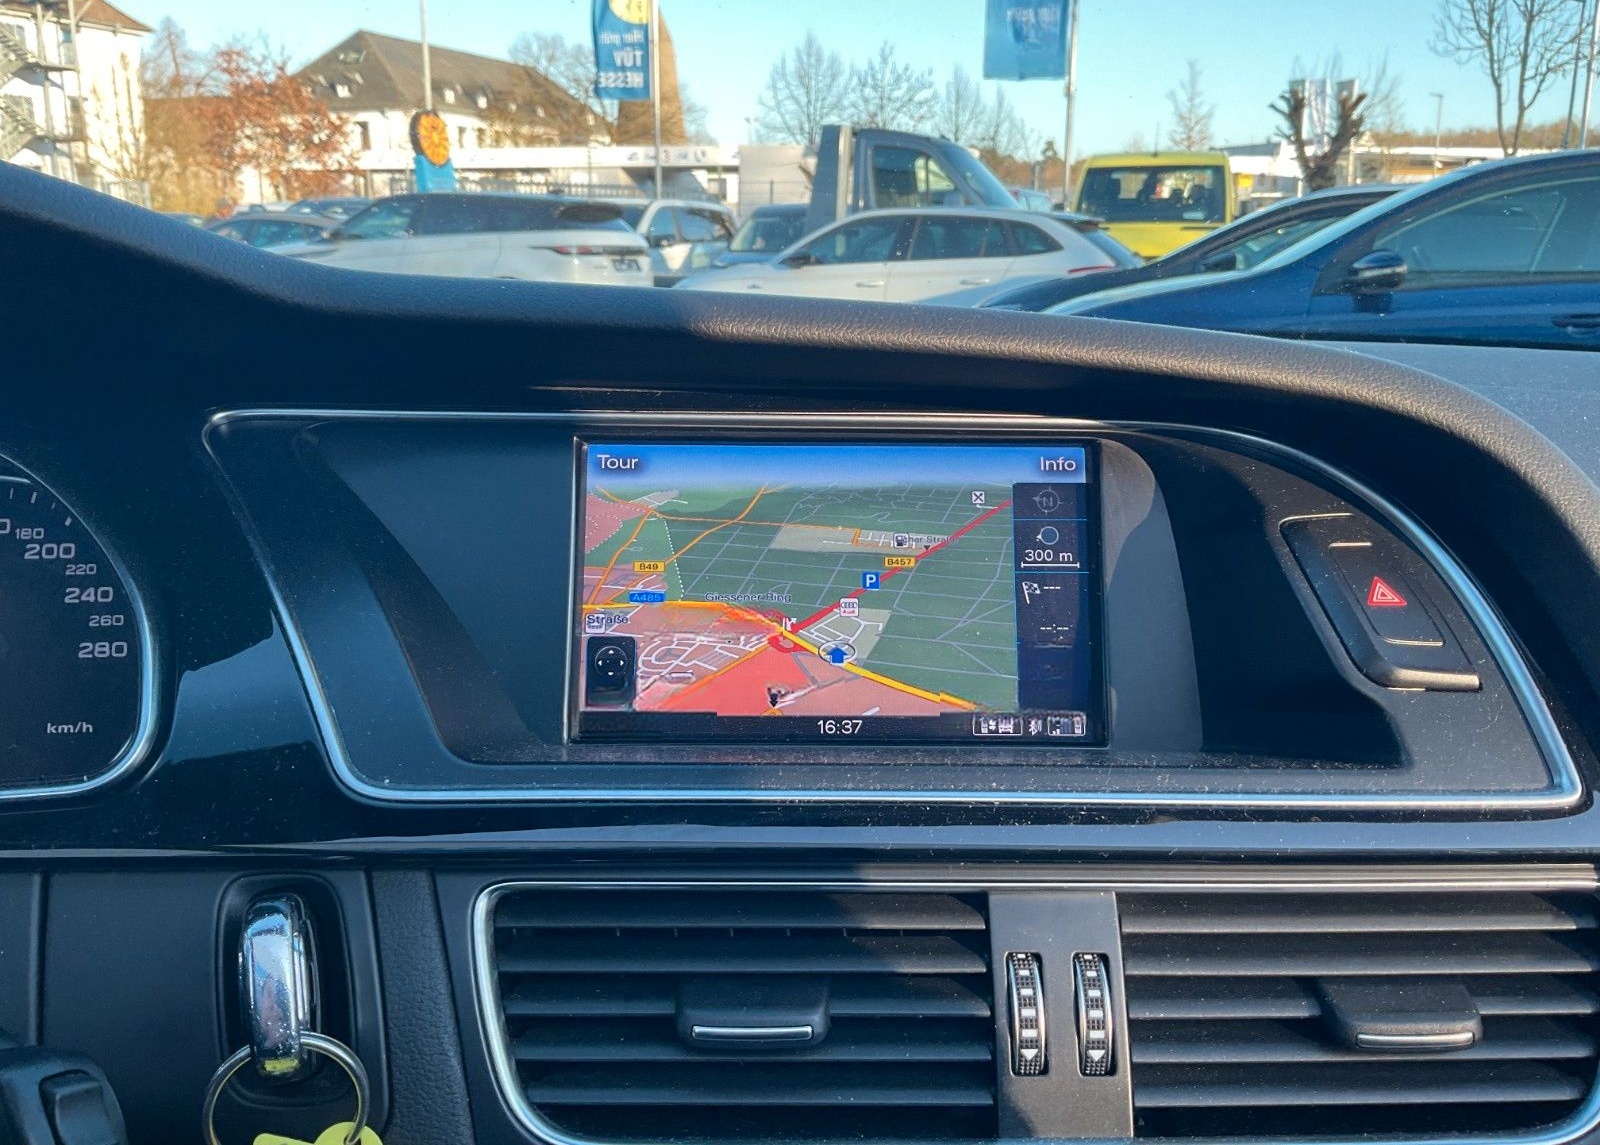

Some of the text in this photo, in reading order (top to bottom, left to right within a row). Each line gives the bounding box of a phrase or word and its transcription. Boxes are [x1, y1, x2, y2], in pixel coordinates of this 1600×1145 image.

[597, 454, 639, 470] Tour
[1040, 456, 1077, 471] Info
[15, 527, 45, 539] 180
[24, 543, 76, 559] 200
[1025, 549, 1073, 562] 300 m
[65, 563, 97, 575] 220
[638, 562, 659, 572] B49
[886, 558, 913, 567] B457
[865, 574, 877, 588] P
[64, 586, 114, 603] 240
[633, 592, 661, 602] A485
[705, 592, 792, 604] Giessener Ring
[89, 614, 124, 627] 260
[586, 614, 629, 624] Straße
[77, 641, 128, 658] 280
[46, 721, 94, 734] km/h
[816, 719, 863, 735] 16:37
